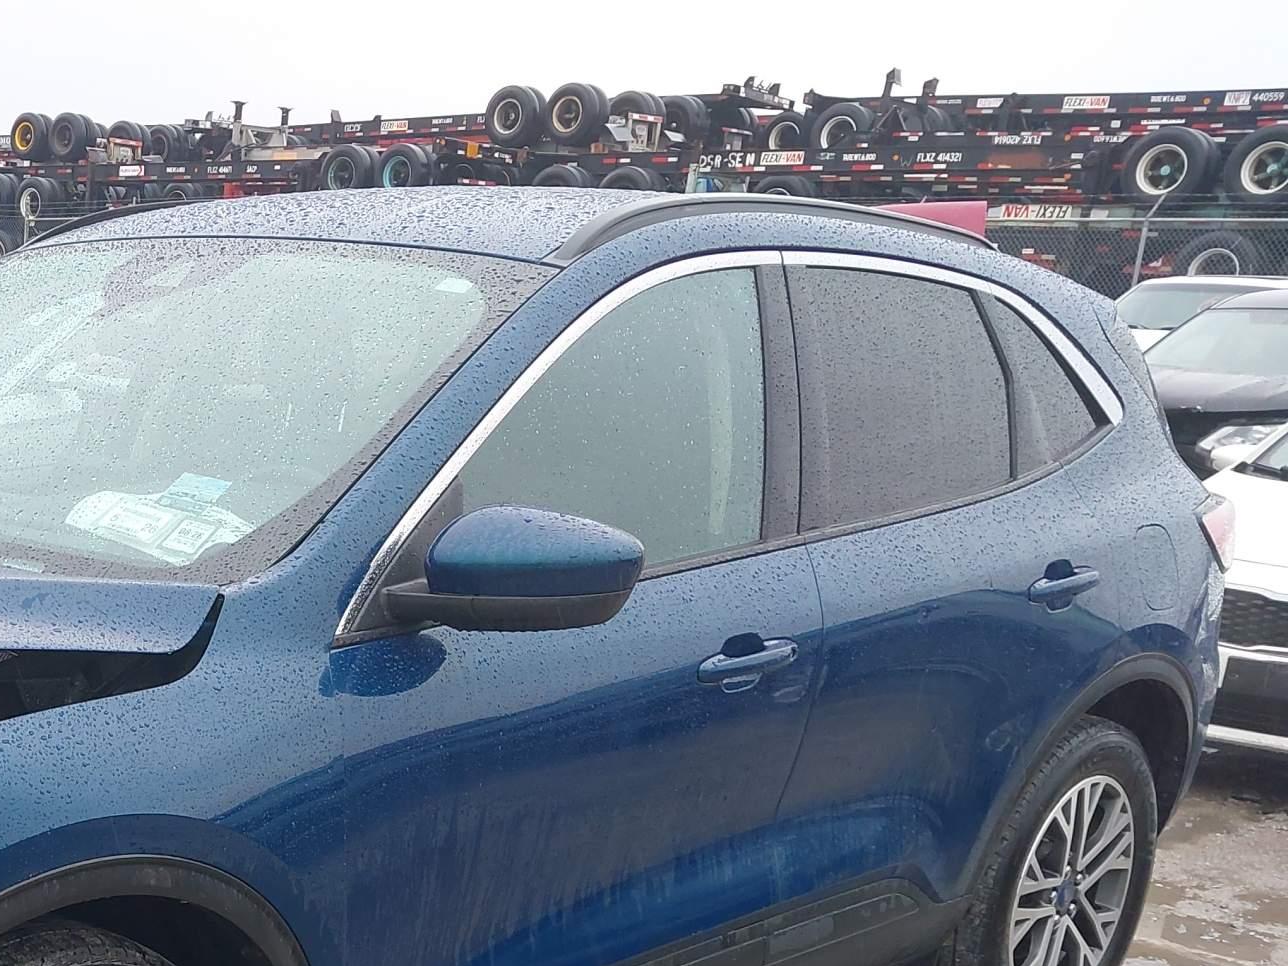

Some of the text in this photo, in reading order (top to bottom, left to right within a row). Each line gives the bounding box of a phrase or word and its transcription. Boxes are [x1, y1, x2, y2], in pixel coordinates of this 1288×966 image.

[1064, 97, 1109, 107] FLEXI-VAN
[1252, 92, 1285, 102] 440559
[761, 152, 804, 164] FLEXI-VAN
[916, 152, 936, 162] FLXZ
[1002, 204, 1069, 218] FLEXI-VAN
